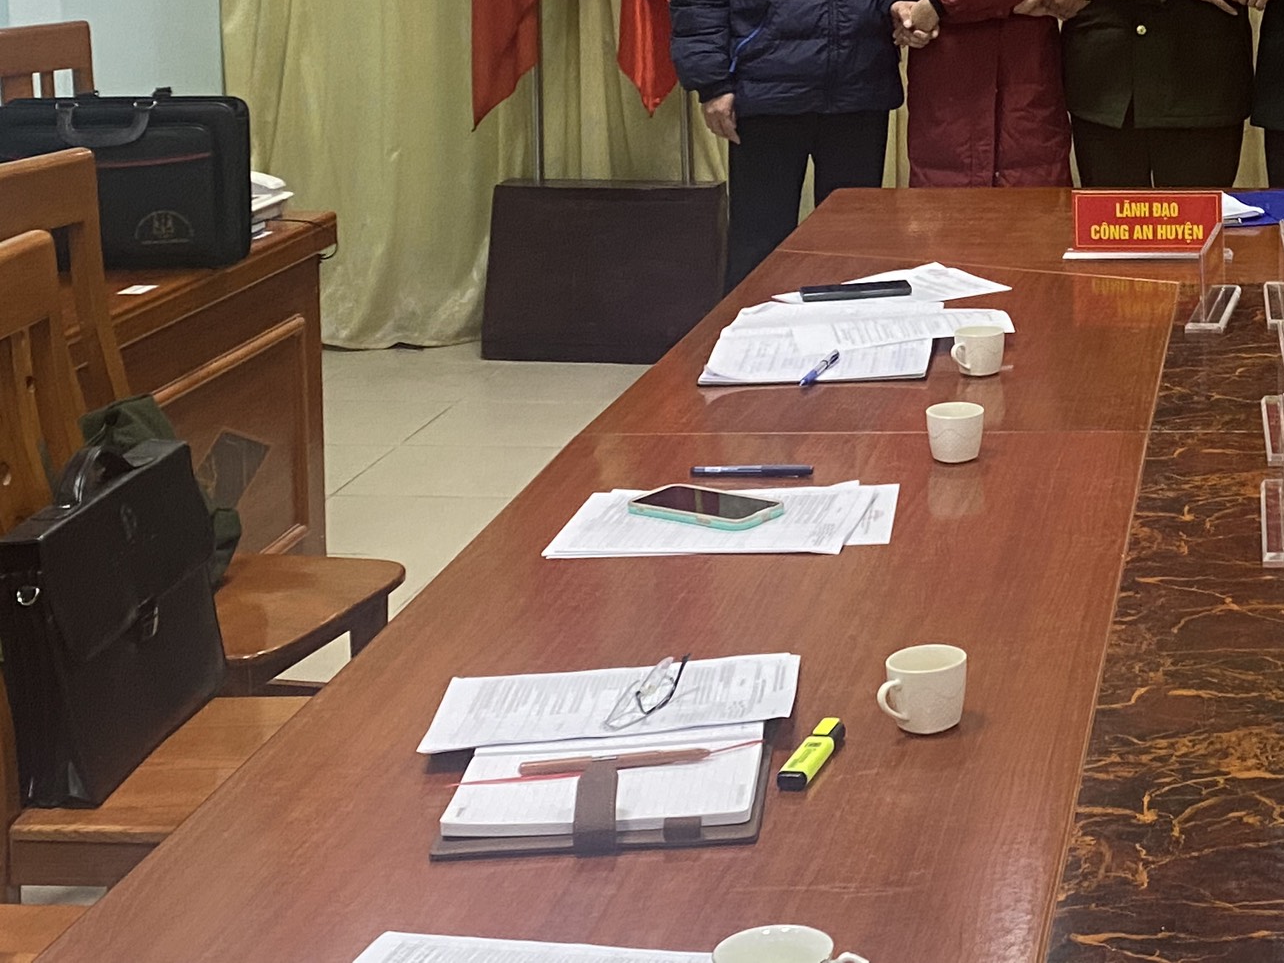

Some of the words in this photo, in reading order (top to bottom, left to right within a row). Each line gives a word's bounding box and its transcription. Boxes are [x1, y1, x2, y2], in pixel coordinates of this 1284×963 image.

[1115, 200, 1149, 217] LÃNH
[1152, 202, 1178, 220] ĐẠO
[1090, 222, 1129, 240] CÔNG
[1133, 224, 1154, 240] AN
[1156, 221, 1203, 243] HUYỆN
